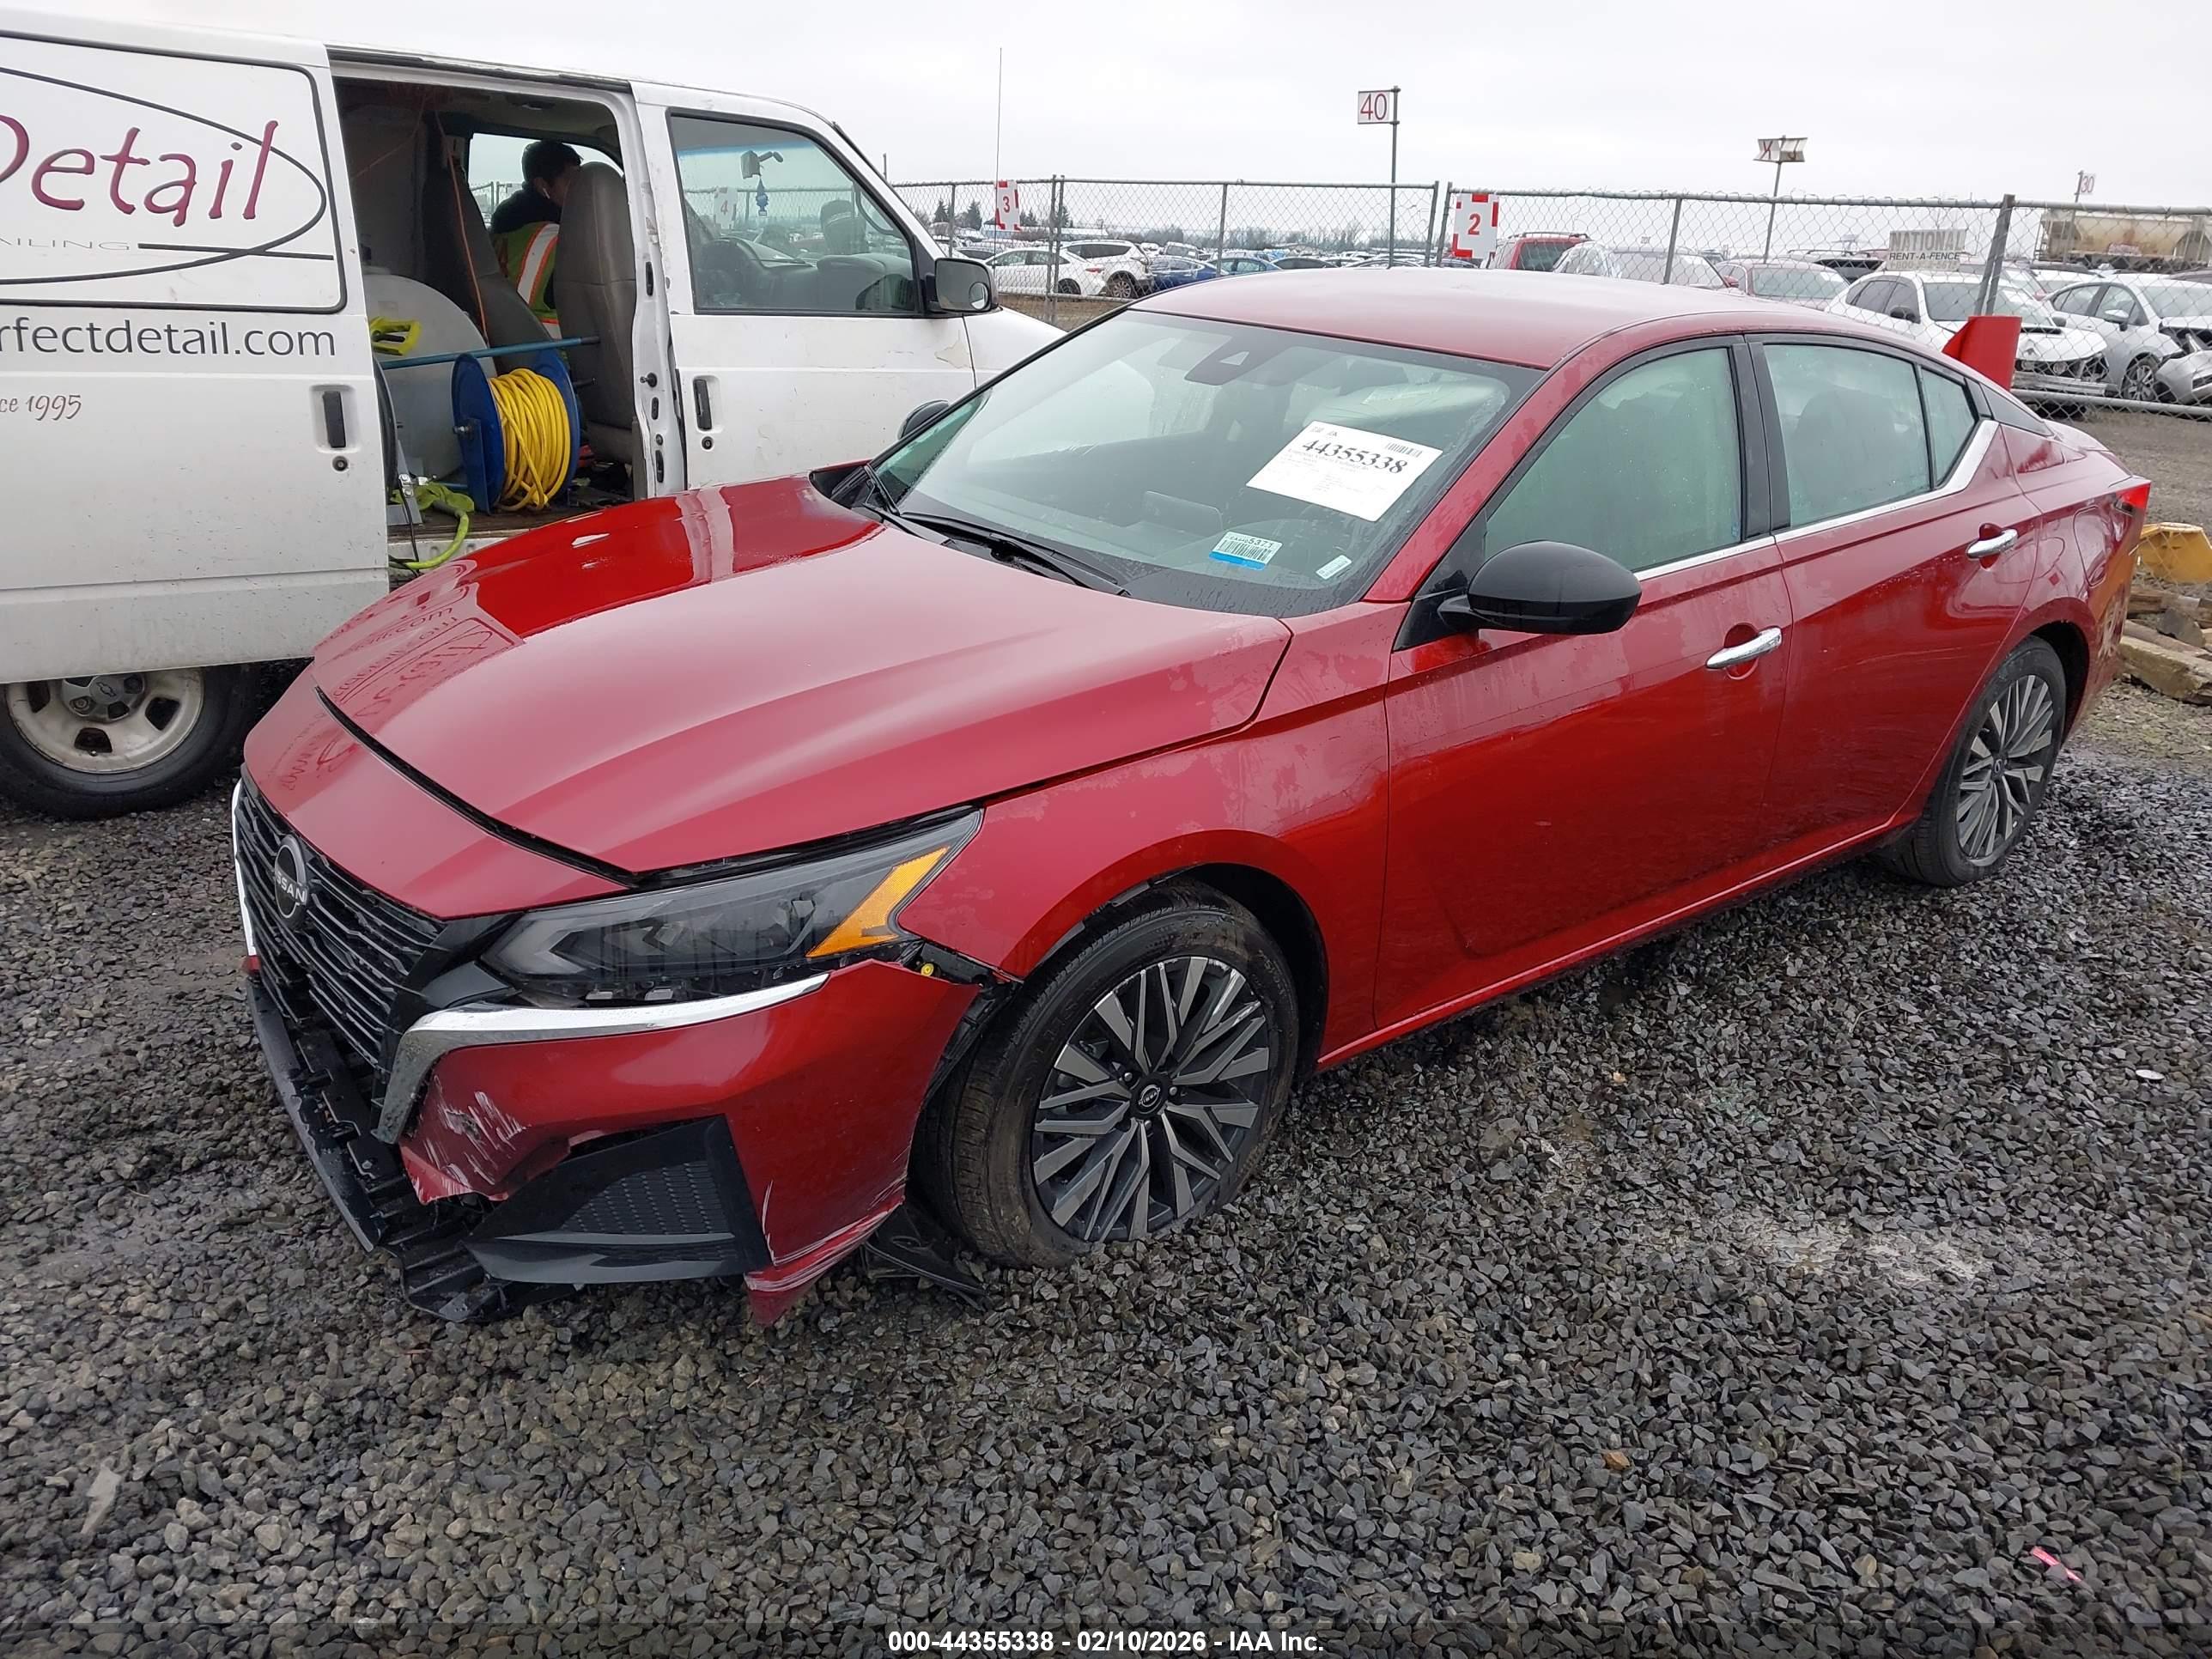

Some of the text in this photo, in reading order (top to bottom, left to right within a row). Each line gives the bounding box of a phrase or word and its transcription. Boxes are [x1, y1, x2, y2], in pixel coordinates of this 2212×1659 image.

[1360, 93, 1387, 120] 40
[2081, 176, 2095, 193] 30
[720, 200, 728, 216] 4
[1003, 196, 1011, 213] 3
[1468, 214, 1480, 234] 2
[1890, 231, 1965, 251] NATIONAL
[26, 394, 82, 421] 1995
[1302, 440, 1407, 474] 44355338
